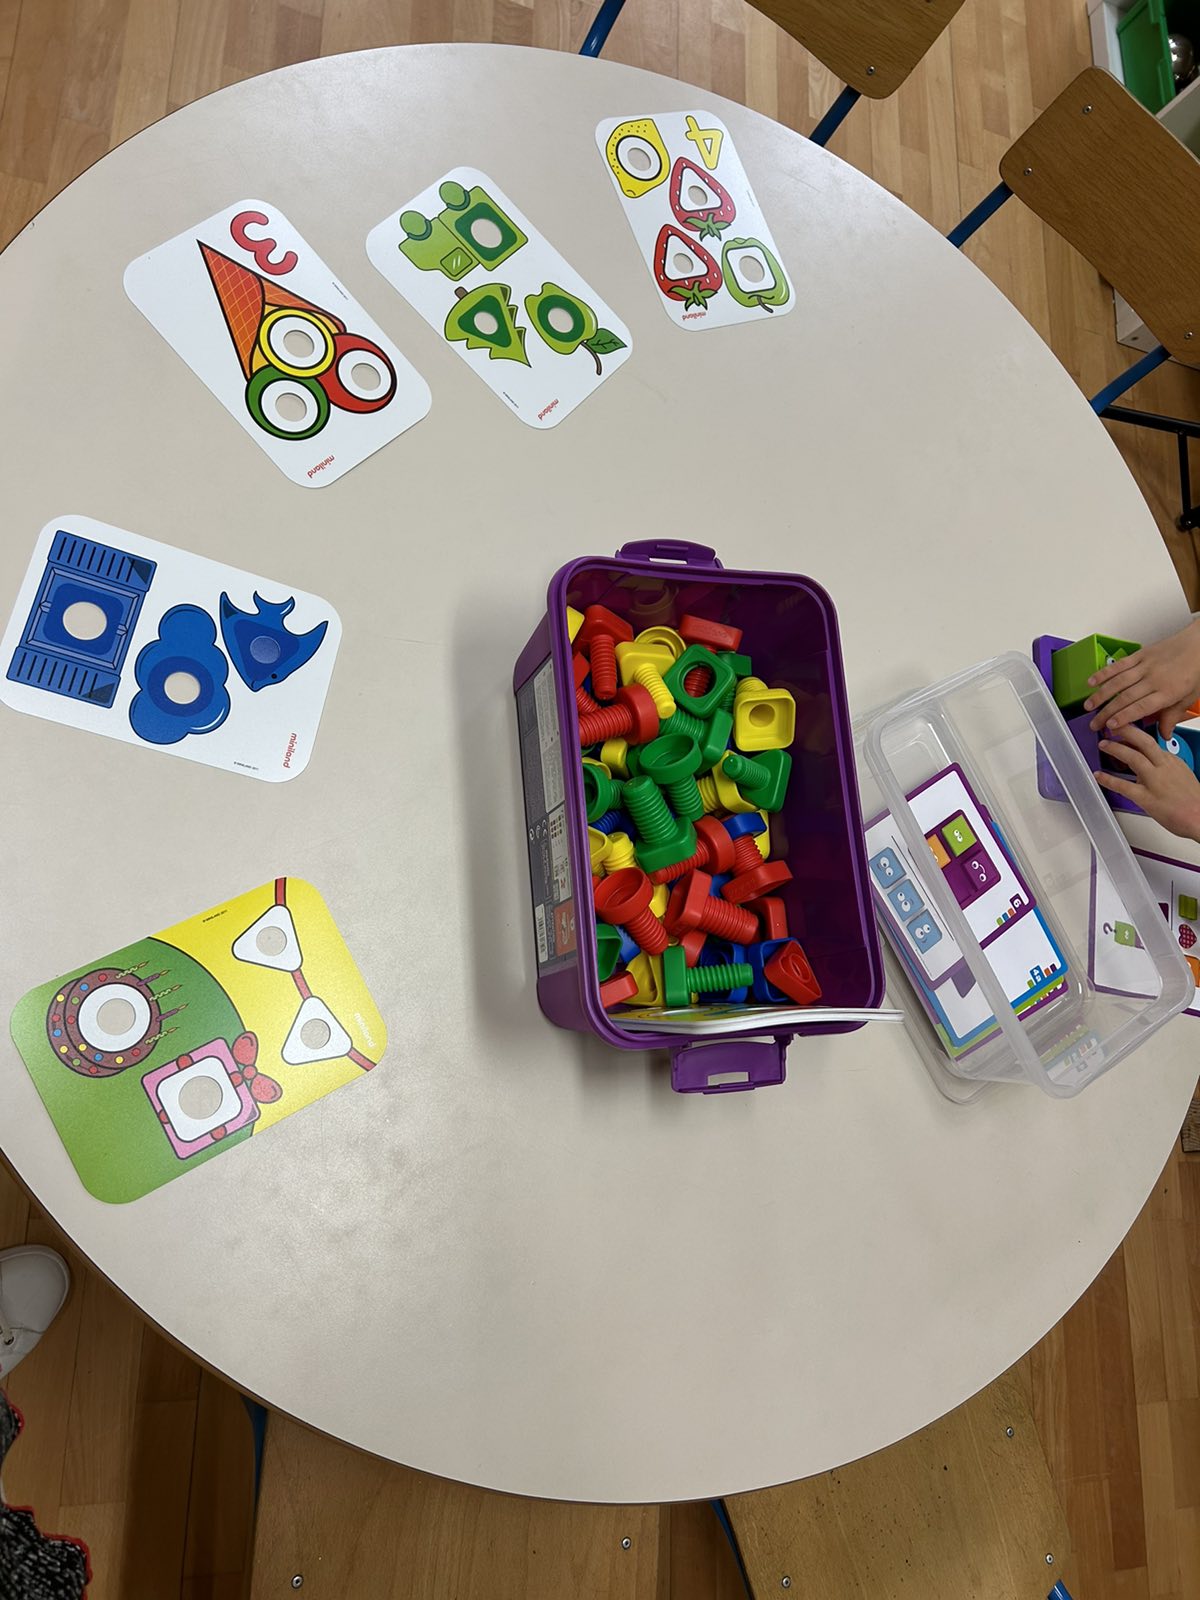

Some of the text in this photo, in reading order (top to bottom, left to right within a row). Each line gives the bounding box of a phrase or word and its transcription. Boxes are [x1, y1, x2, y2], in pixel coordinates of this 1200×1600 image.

[685, 115, 724, 170] 4
[230, 211, 298, 275] 3
[537, 398, 559, 421] miniland
[307, 455, 335, 479] miniland
[283, 732, 297, 769] miniland
[1033, 969, 1042, 982] 4a
[354, 1013, 376, 1048] miniland
